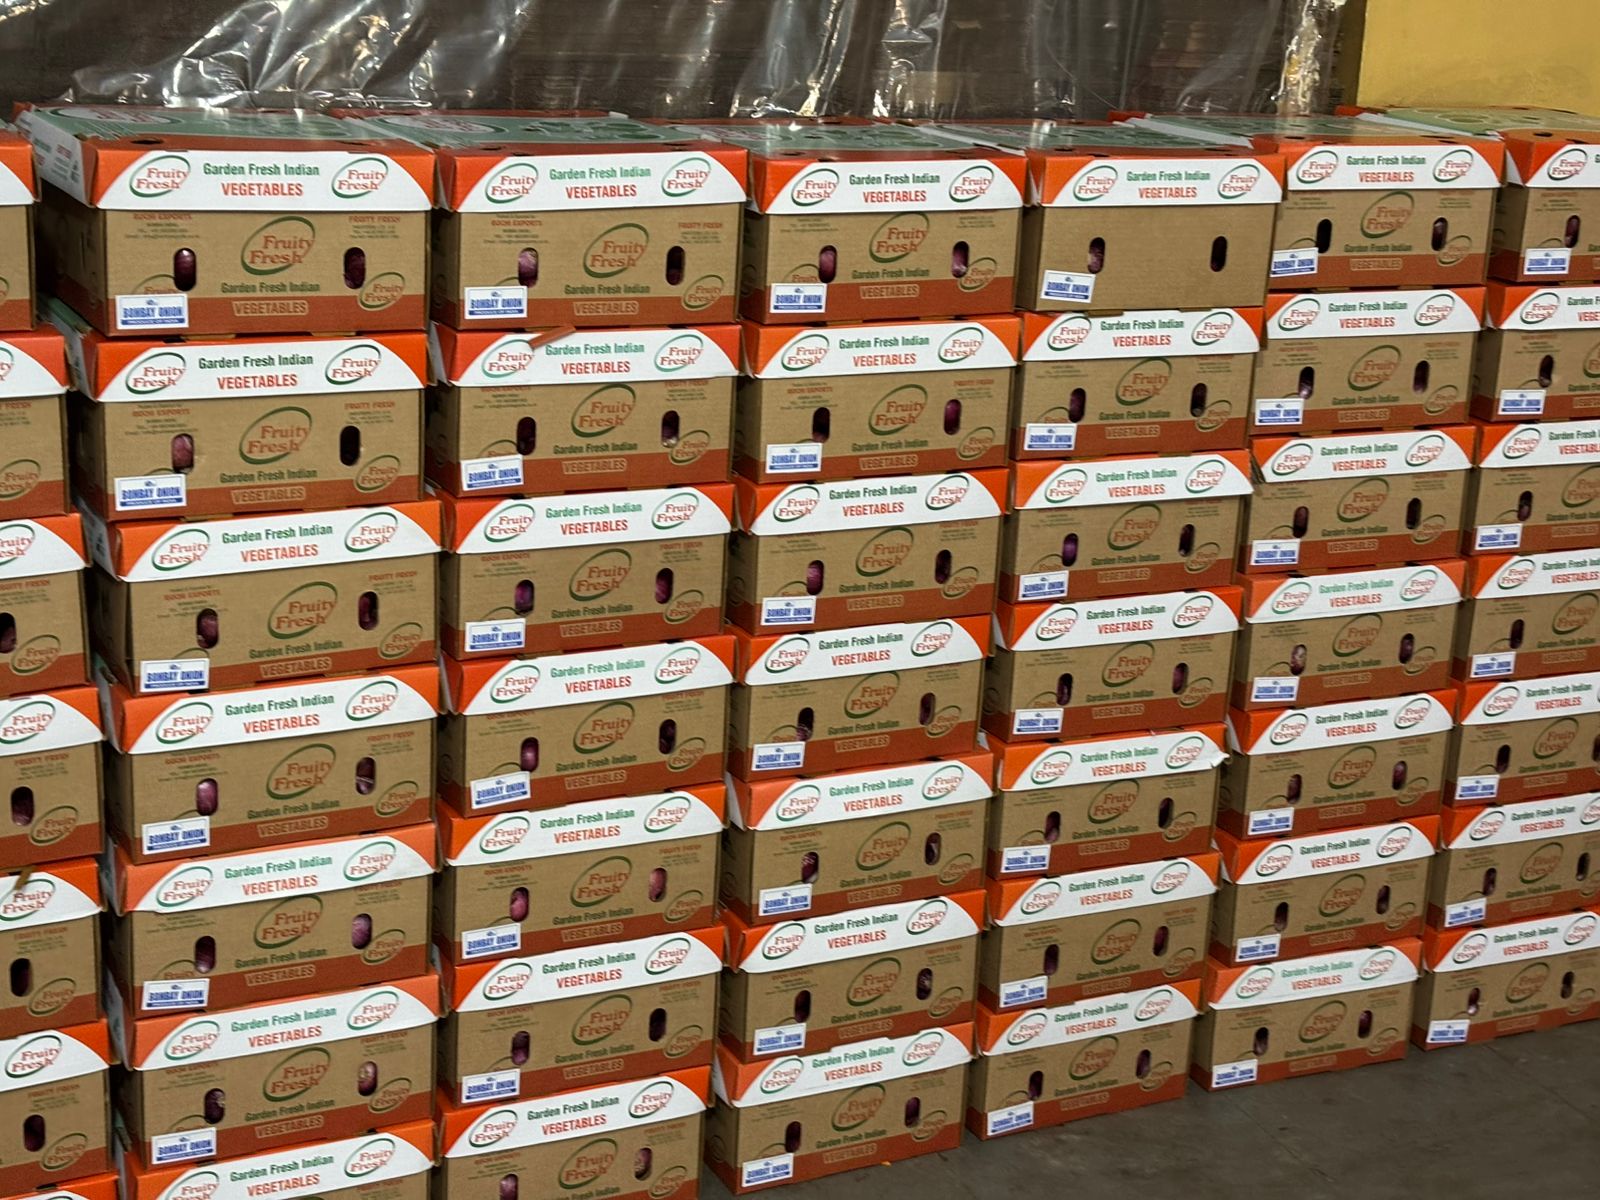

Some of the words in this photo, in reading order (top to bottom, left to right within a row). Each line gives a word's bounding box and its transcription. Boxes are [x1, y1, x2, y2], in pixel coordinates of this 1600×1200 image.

[1347, 156, 1375, 166] Garden
[1377, 155, 1399, 165] Fresh
[1401, 155, 1426, 165] Indian
[147, 168, 190, 180] Fruity
[204, 163, 245, 176] Garden
[249, 164, 281, 175] Fresh
[284, 164, 320, 176] Indian
[348, 170, 387, 180] Fruity
[550, 167, 585, 181] Garden
[589, 166, 617, 179] Fresh
[620, 165, 651, 178] Indian
[676, 168, 710, 179] Fruity
[1126, 171, 1156, 182] Garden
[1159, 171, 1182, 181] Fresh
[1184, 170, 1211, 181] Indian
[1358, 171, 1414, 182] VEGETABLES
[136, 179, 180, 188] Fresh
[338, 180, 379, 189] Fresh
[500, 174, 538, 187] Fruity
[667, 178, 702, 189] Fresh
[849, 173, 881, 186] Garden
[884, 173, 910, 184] Fresh
[912, 173, 941, 184] Indian
[221, 183, 304, 196] VEGETABLES
[491, 184, 529, 196] Fresh
[565, 184, 637, 199] VEGETABLES
[863, 190, 927, 203] VEGETABLES
[1138, 186, 1197, 198] VEGETABLES
[263, 235, 314, 250] Fruity
[603, 240, 648, 254] Fruity
[249, 250, 303, 263] Fresh
[590, 254, 637, 267] Fresh
[222, 282, 257, 293] Garden
[259, 282, 287, 292] Fresh
[289, 281, 320, 292] Indian
[234, 302, 306, 314] VEGETABLES
[1101, 321, 1130, 332] Garden
[1132, 320, 1156, 330] Fresh
[1158, 319, 1184, 329] Indian
[1339, 316, 1395, 328] VEGETABLES
[839, 338, 871, 350] Garden
[874, 336, 899, 348] Fresh
[901, 335, 930, 346] Indian
[1112, 334, 1172, 347] VEGETABLES
[546, 344, 581, 357] Garden
[584, 343, 611, 355] Fresh
[614, 342, 645, 354] Indian
[199, 356, 239, 370] Garden
[243, 355, 275, 368] Fresh
[278, 353, 314, 366] Indian
[341, 356, 380, 367] Fruity
[852, 352, 916, 367] VEGETABLES
[143, 364, 186, 378] Fruity
[331, 366, 371, 377] Fresh
[561, 360, 631, 375] VEGETABLES
[133, 374, 176, 386] Fresh
[217, 373, 298, 389] VEGETABLES
[590, 400, 635, 415] Fruity
[578, 413, 625, 427] Fresh
[261, 423, 311, 440] Fruity
[247, 438, 300, 454] Fresh
[1332, 457, 1386, 471] VEGETABLES
[829, 488, 860, 501] Garden
[863, 487, 888, 498] Fresh
[890, 484, 917, 496] Indian
[1108, 483, 1165, 497] VEGETABLES
[546, 505, 580, 519] Garden
[583, 503, 610, 516] Fresh
[612, 501, 642, 514] Indian
[665, 502, 697, 513] Fruity
[842, 501, 904, 516] VEGETABLES
[499, 514, 535, 527] Fruity
[656, 511, 690, 522] Fresh
[222, 529, 262, 545] Garden
[265, 526, 296, 540] Fresh
[299, 523, 333, 537] Indian
[360, 522, 397, 535] Fruity
[490, 523, 526, 535] Fresh
[560, 519, 628, 536] VEGETABLES
[350, 532, 389, 545] Fresh
[169, 539, 210, 555] Fruity
[240, 542, 319, 563] VEGETABLES
[159, 550, 201, 564] Fresh
[588, 563, 630, 579] Fruity
[575, 577, 621, 592] Fresh
[288, 596, 337, 615] Fruity
[1329, 593, 1382, 608] VEGETABLES
[275, 611, 326, 629] Fresh
[1097, 619, 1154, 635] VEGETABLES
[250, 645, 283, 659] Garden
[285, 642, 311, 654] Fresh
[314, 638, 342, 651] Indian
[831, 648, 891, 666] VEGETABLES
[262, 658, 330, 676] VEGETABLES
[551, 664, 584, 679] Garden
[587, 661, 613, 674] Fresh
[616, 657, 645, 671] Indian
[565, 675, 632, 694] VEGETABLES
[225, 701, 264, 717] Garden
[268, 697, 298, 711] Fresh
[301, 693, 335, 708] Indian
[1534, 696, 1581, 710] VEGETABLES
[12, 712, 54, 726] Fruity
[243, 712, 320, 734] VEGETABLES
[591, 715, 634, 732] Fruity
[2, 723, 46, 737] Fresh
[580, 728, 624, 745] Fresh
[1325, 722, 1377, 738] VEGETABLES
[287, 758, 335, 777] Fruity
[1091, 761, 1146, 777] VEGETABLES
[274, 772, 324, 790] Fresh
[843, 793, 902, 812] VEGETABLES
[540, 815, 574, 830] Garden
[576, 811, 603, 824] Fresh
[605, 807, 635, 821] Indian
[1519, 818, 1565, 833] VEGETABLES
[554, 825, 621, 844] VEGETABLES
[225, 864, 263, 880] Garden
[266, 859, 296, 873] Fresh
[299, 854, 333, 869] Indian
[1310, 851, 1360, 868] VEGETABLES
[242, 873, 317, 895] VEGETABLES
[13, 891, 53, 903] Fruity
[1079, 888, 1133, 906] VEGETABLES
[3, 901, 46, 914] Fresh
[827, 928, 886, 949] VEGETABLES
[1502, 939, 1548, 956] VEGETABLES
[542, 959, 575, 975] Garden
[578, 955, 604, 968] Fresh
[607, 950, 636, 964] Indian
[556, 968, 622, 989] VEGETABLES
[1291, 974, 1342, 991] VEGETABLES
[1064, 1016, 1117, 1035] VEGETABLES
[248, 1024, 322, 1047] VEGETABLES
[21, 1046, 60, 1062] Fruity
[12, 1057, 53, 1072] Fresh
[823, 1061, 882, 1082] VEGETABLES
[541, 1112, 606, 1135] VEGETABLES
[247, 1172, 320, 1198] VEGETABLES
